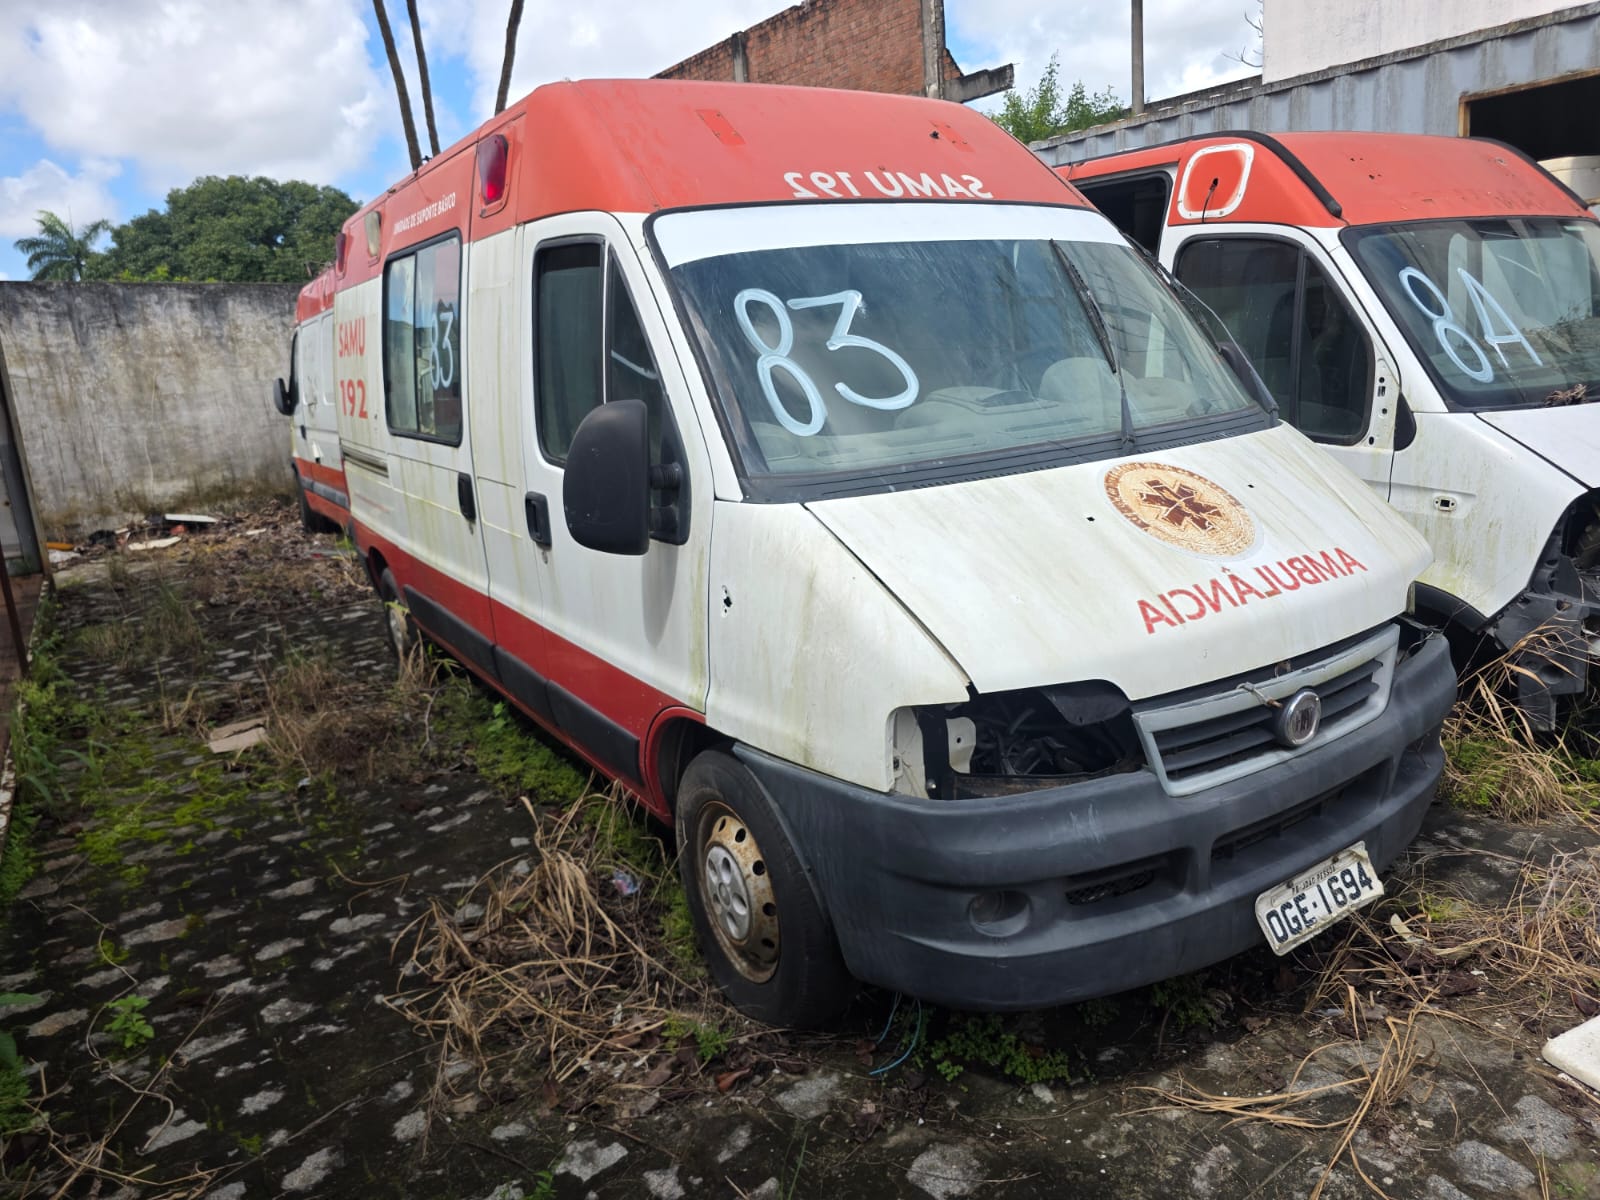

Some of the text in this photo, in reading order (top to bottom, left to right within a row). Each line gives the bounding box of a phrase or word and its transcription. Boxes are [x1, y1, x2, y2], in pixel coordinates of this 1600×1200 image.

[417, 202, 437, 226] SUPORTE
[339, 316, 365, 358] SAMU
[429, 311, 454, 390] 83
[734, 288, 919, 436] 83
[340, 379, 368, 419] 192
